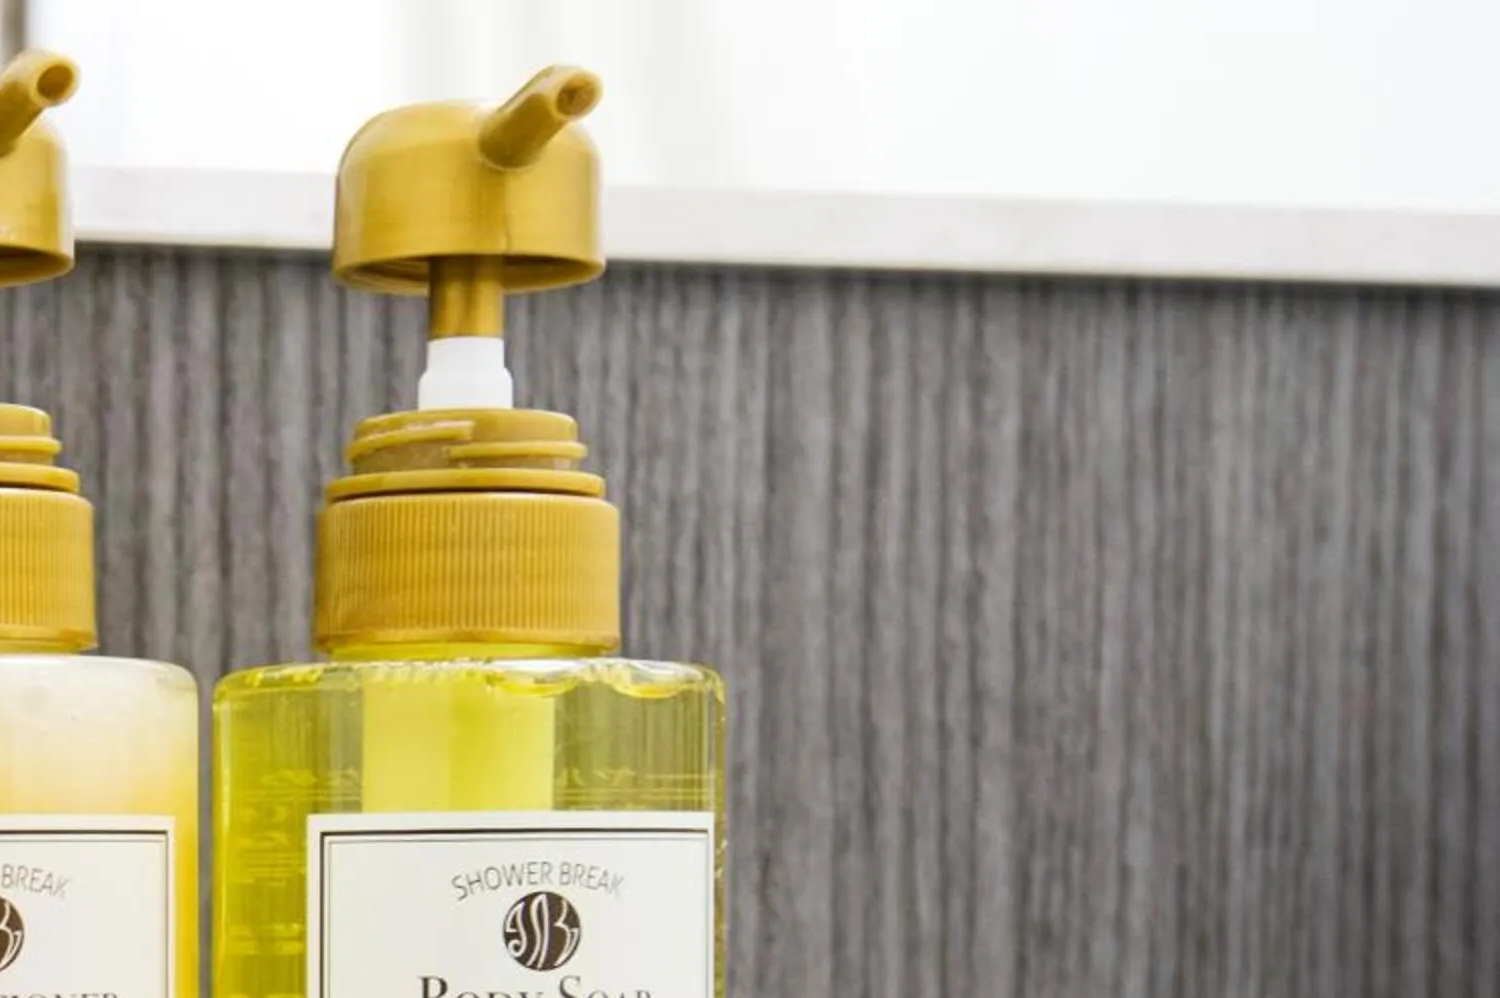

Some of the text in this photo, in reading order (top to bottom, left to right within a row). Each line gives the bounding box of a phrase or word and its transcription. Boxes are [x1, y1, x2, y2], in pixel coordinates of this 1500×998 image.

[1, 864, 73, 899] BREAK
[451, 861, 624, 900] SHOWER BREAK
